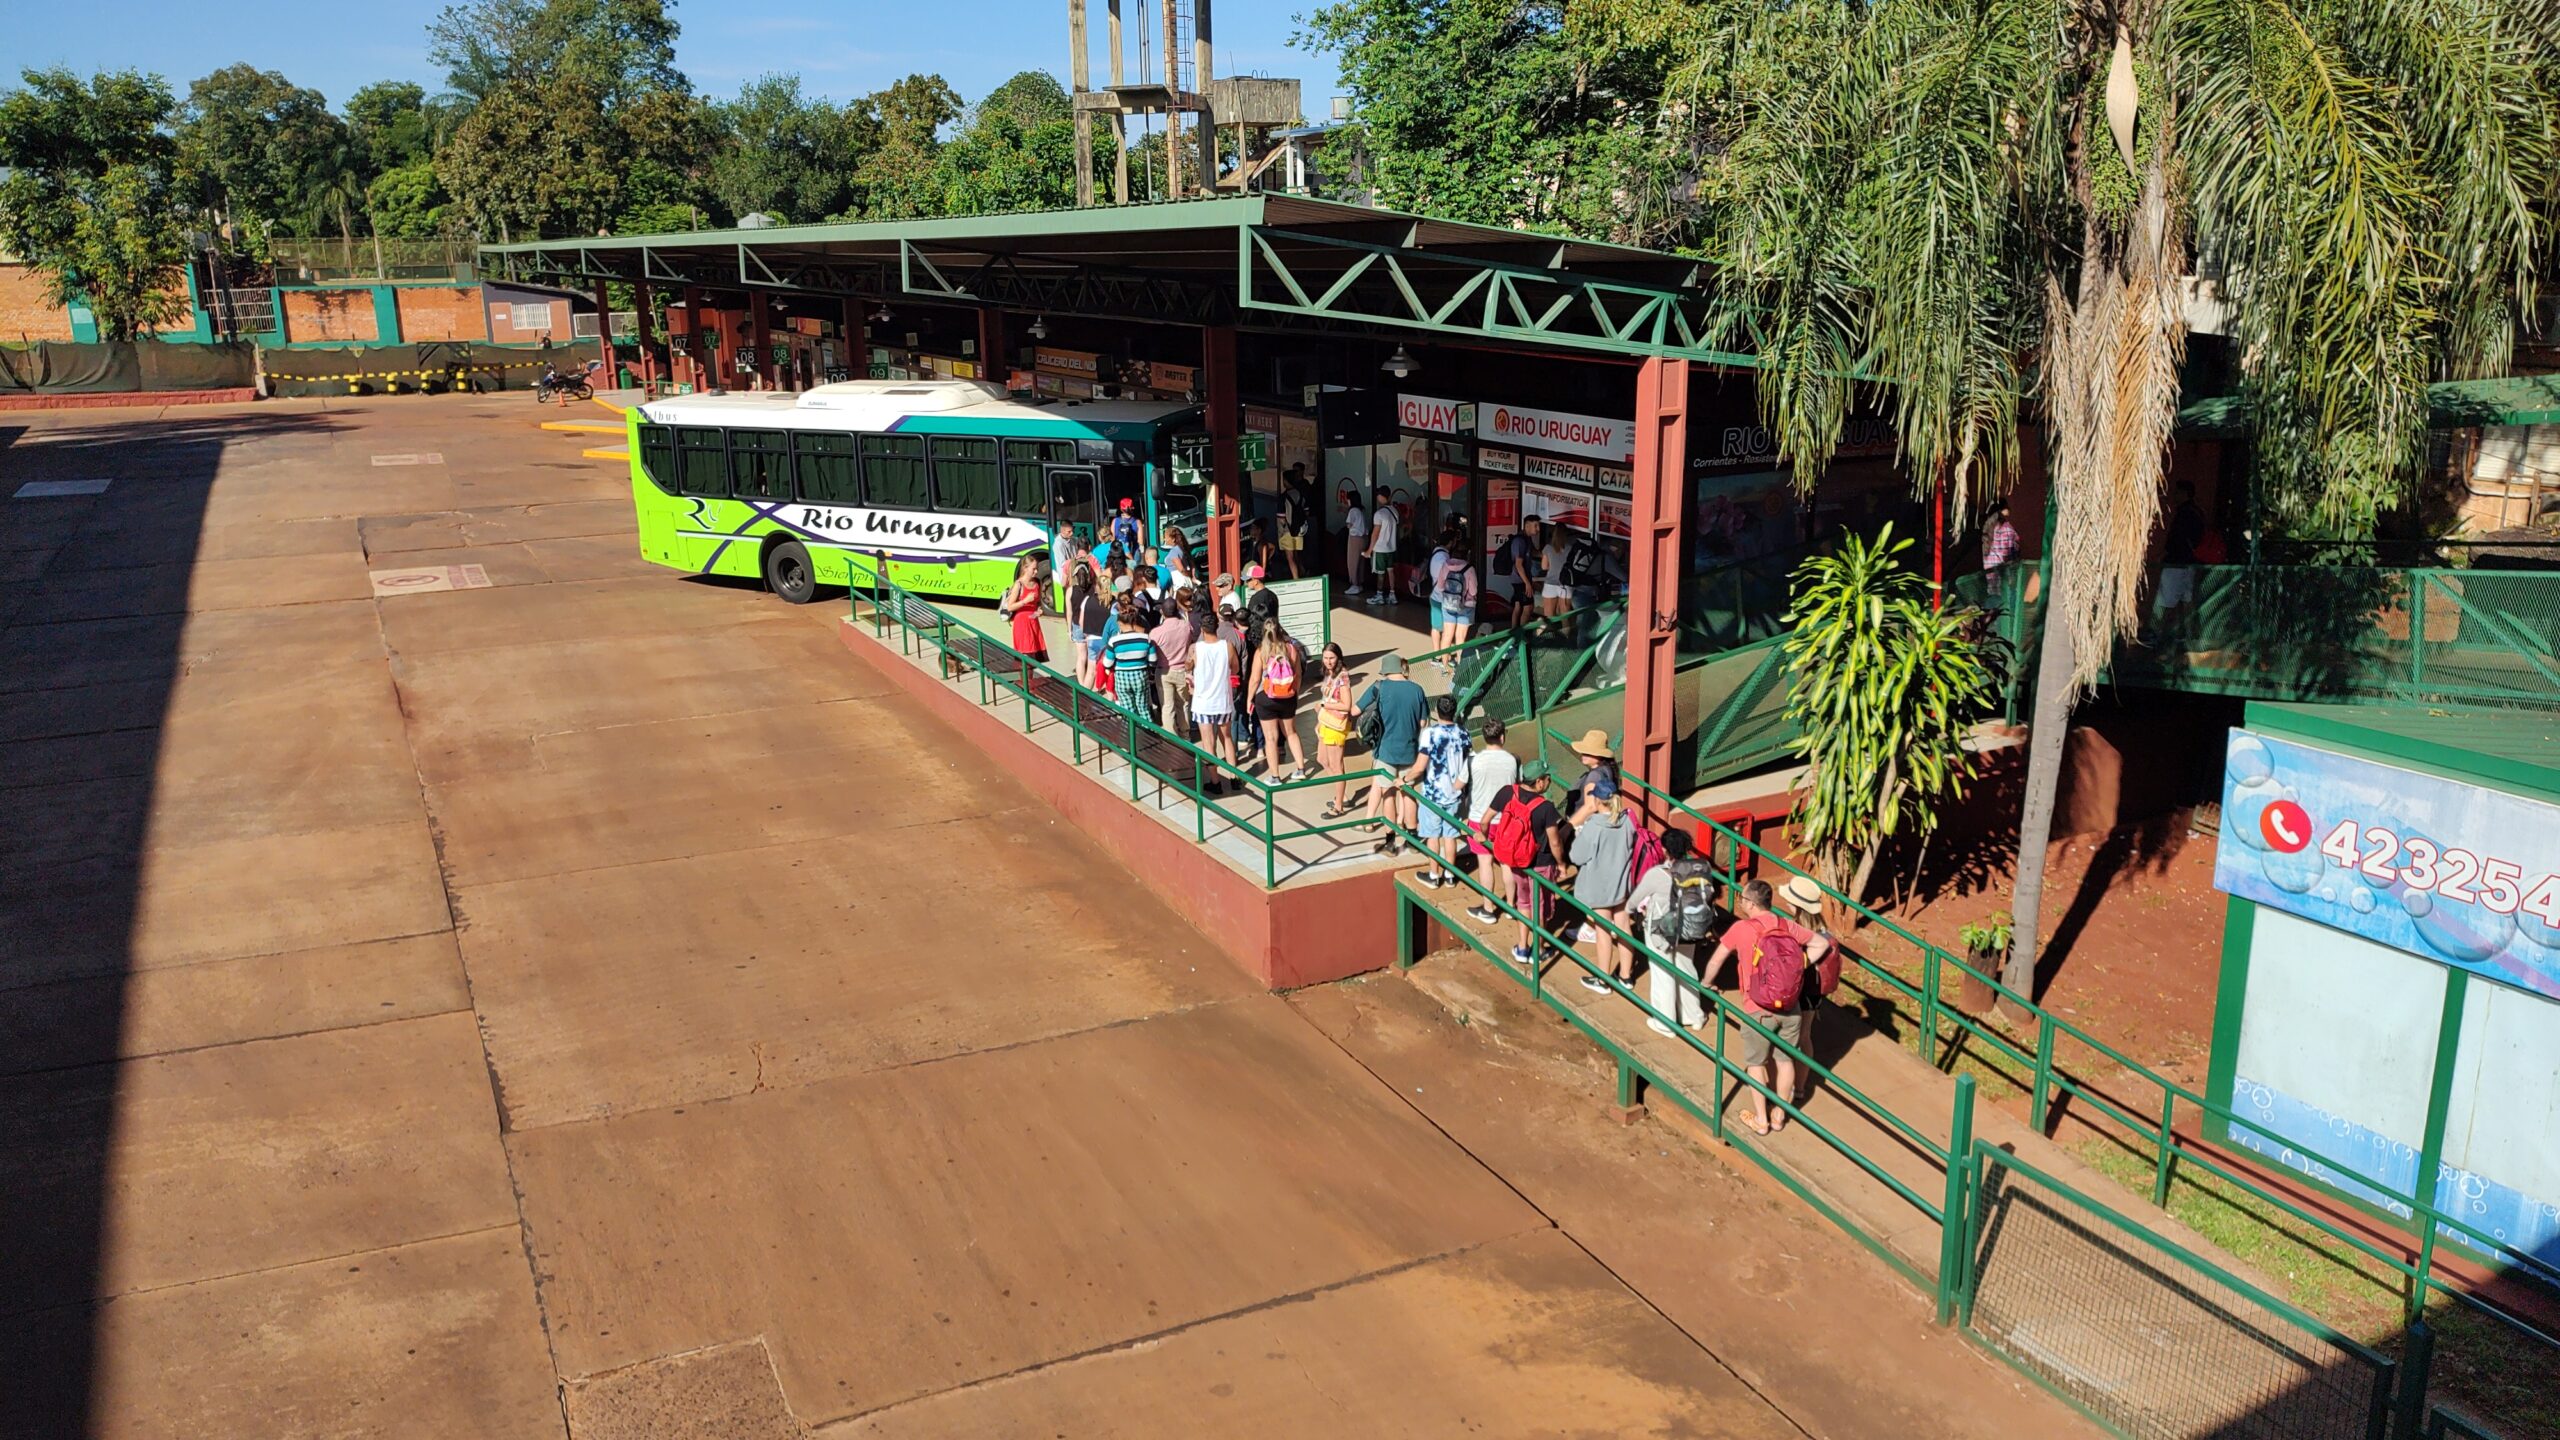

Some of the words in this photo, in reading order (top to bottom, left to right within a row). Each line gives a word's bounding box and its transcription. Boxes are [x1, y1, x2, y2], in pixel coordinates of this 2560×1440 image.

[674, 338, 688, 349] 07
[740, 352, 755, 363] 08
[773, 349, 788, 358] 08
[1068, 358, 1084, 370] DEL
[869, 368, 886, 379] 09
[1460, 410, 1473, 422] 20
[1511, 415, 1536, 436] RIO
[1539, 420, 1612, 447] URUGUAY
[1722, 426, 1771, 457] RIO
[1185, 446, 1204, 467] 11
[1239, 442, 1257, 459] 11
[1487, 450, 1496, 458] BUY
[1498, 452, 1511, 460] YOUR
[1484, 460, 1501, 468] TICKET
[1501, 463, 1516, 471] HERE
[1527, 458, 1592, 483] WATERFALL
[801, 507, 852, 531] Rio
[866, 511, 1012, 547] Uruguay
[897, 574, 952, 589] Junto
[957, 582, 968, 590] a
